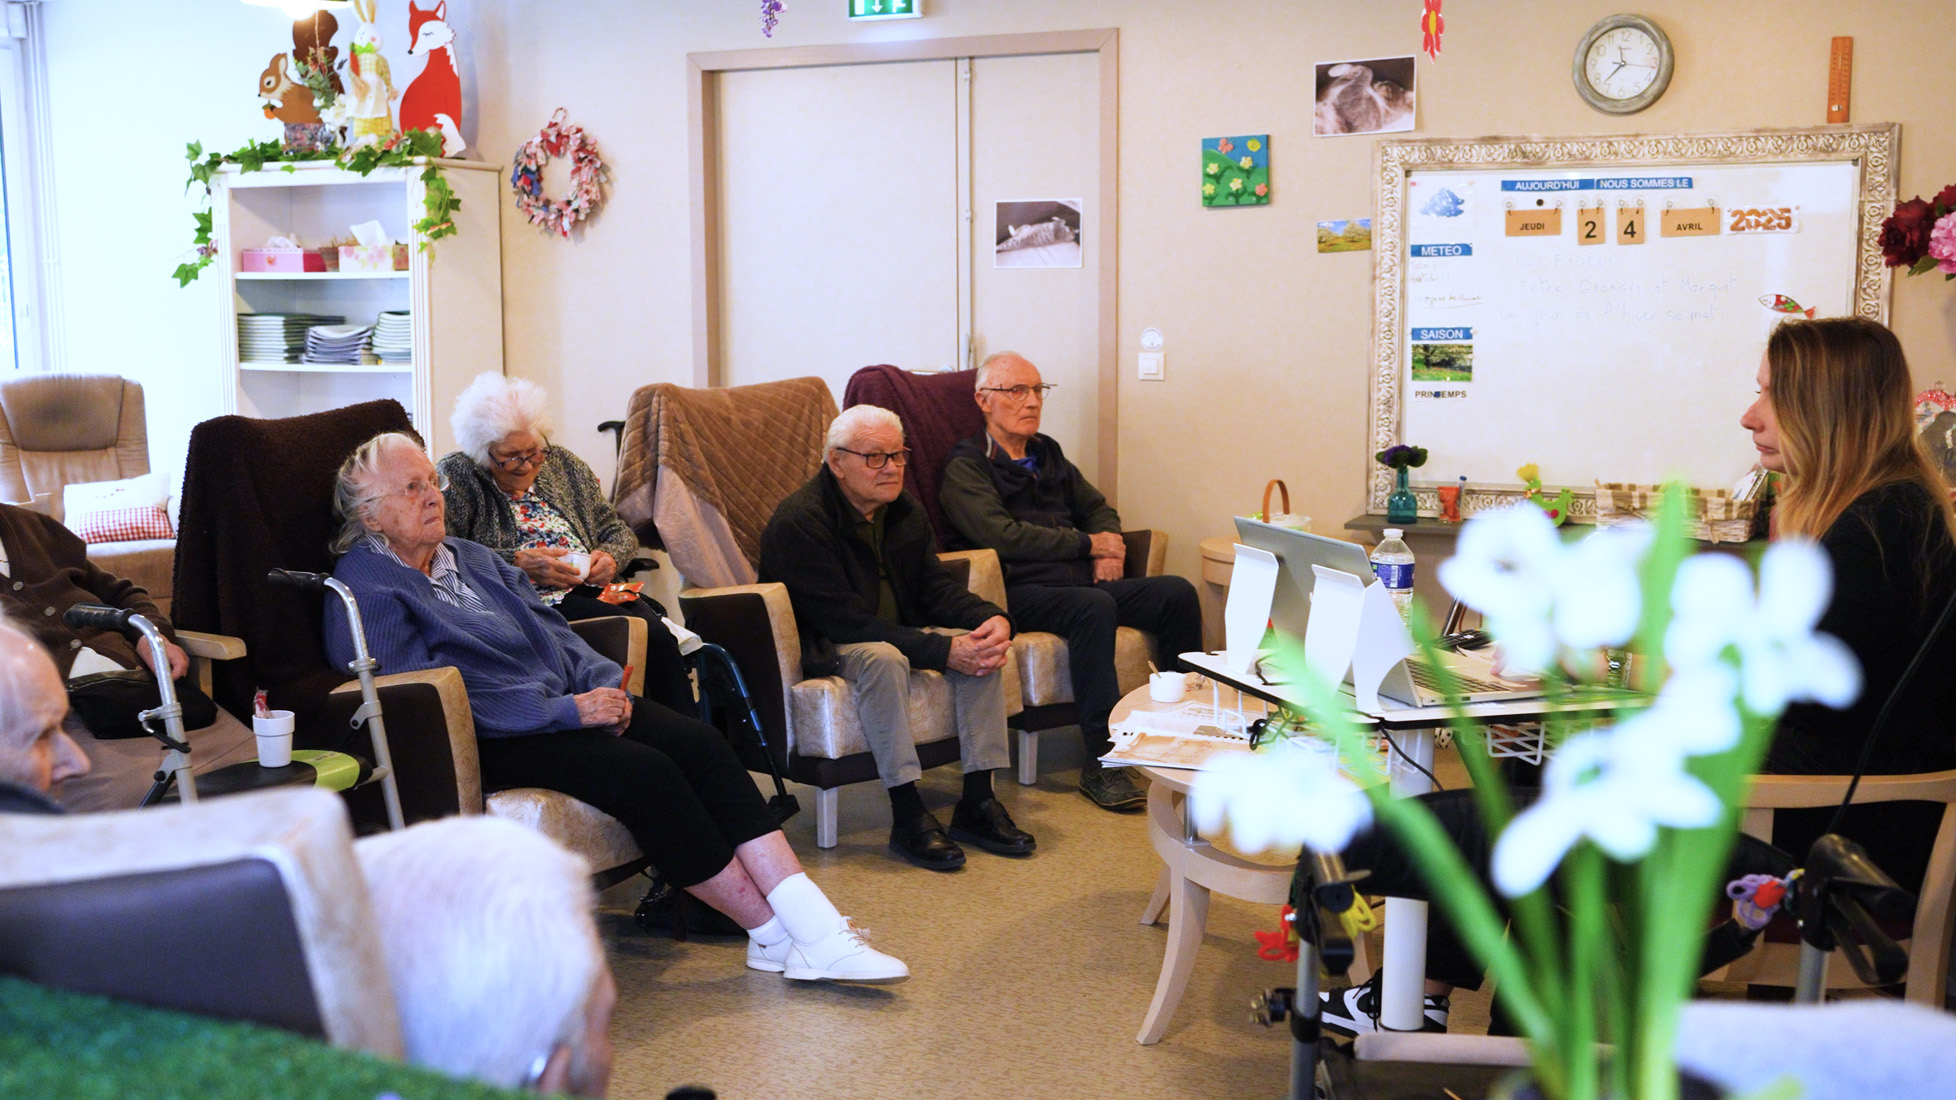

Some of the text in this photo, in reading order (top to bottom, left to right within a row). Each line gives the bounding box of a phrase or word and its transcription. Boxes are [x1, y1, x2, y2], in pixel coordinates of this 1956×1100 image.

[1607, 34, 1615, 45] 11
[1621, 30, 1632, 42] 12
[1595, 44, 1606, 57] 10
[1646, 43, 1654, 55] 2
[1590, 58, 1597, 69] 9
[1650, 57, 1658, 69] 3
[1594, 73, 1601, 85] 8
[1644, 72, 1651, 82] 4
[1617, 86, 1625, 97] 6
[1633, 81, 1640, 93] 5
[1515, 178, 1688, 191] AUJOURD'HUI NOUS SOMMES LE
[1730, 207, 1791, 232] 2025
[1519, 222, 1545, 231] JEUDI
[1584, 221, 1597, 239] 2
[1623, 220, 1637, 238] 4
[1676, 222, 1703, 231] AVRIL
[1421, 245, 1462, 256] METEO
[1420, 329, 1464, 340] SAISON
[1415, 390, 1467, 398] PRINEMPS
